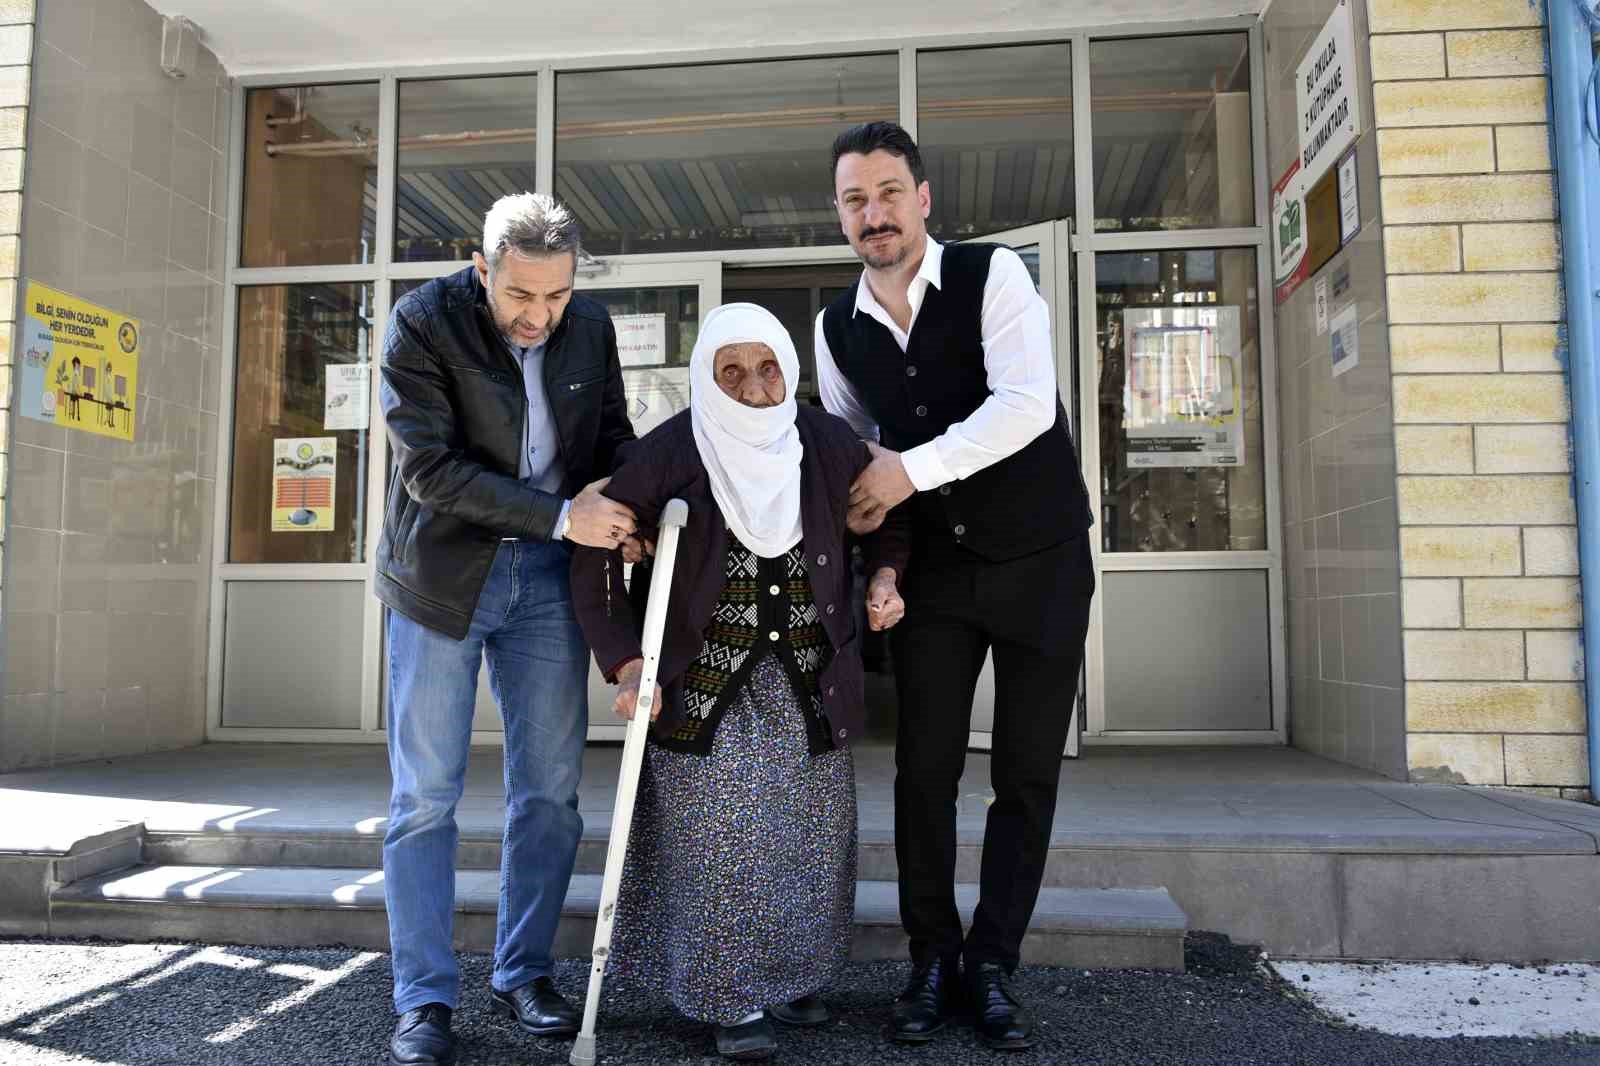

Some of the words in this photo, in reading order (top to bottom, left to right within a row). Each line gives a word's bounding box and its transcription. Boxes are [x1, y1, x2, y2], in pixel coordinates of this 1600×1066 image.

[1306, 71, 1314, 94] BU
[1314, 37, 1336, 82] OKULDA
[1304, 96, 1349, 169] BULUNMAKTADIR
